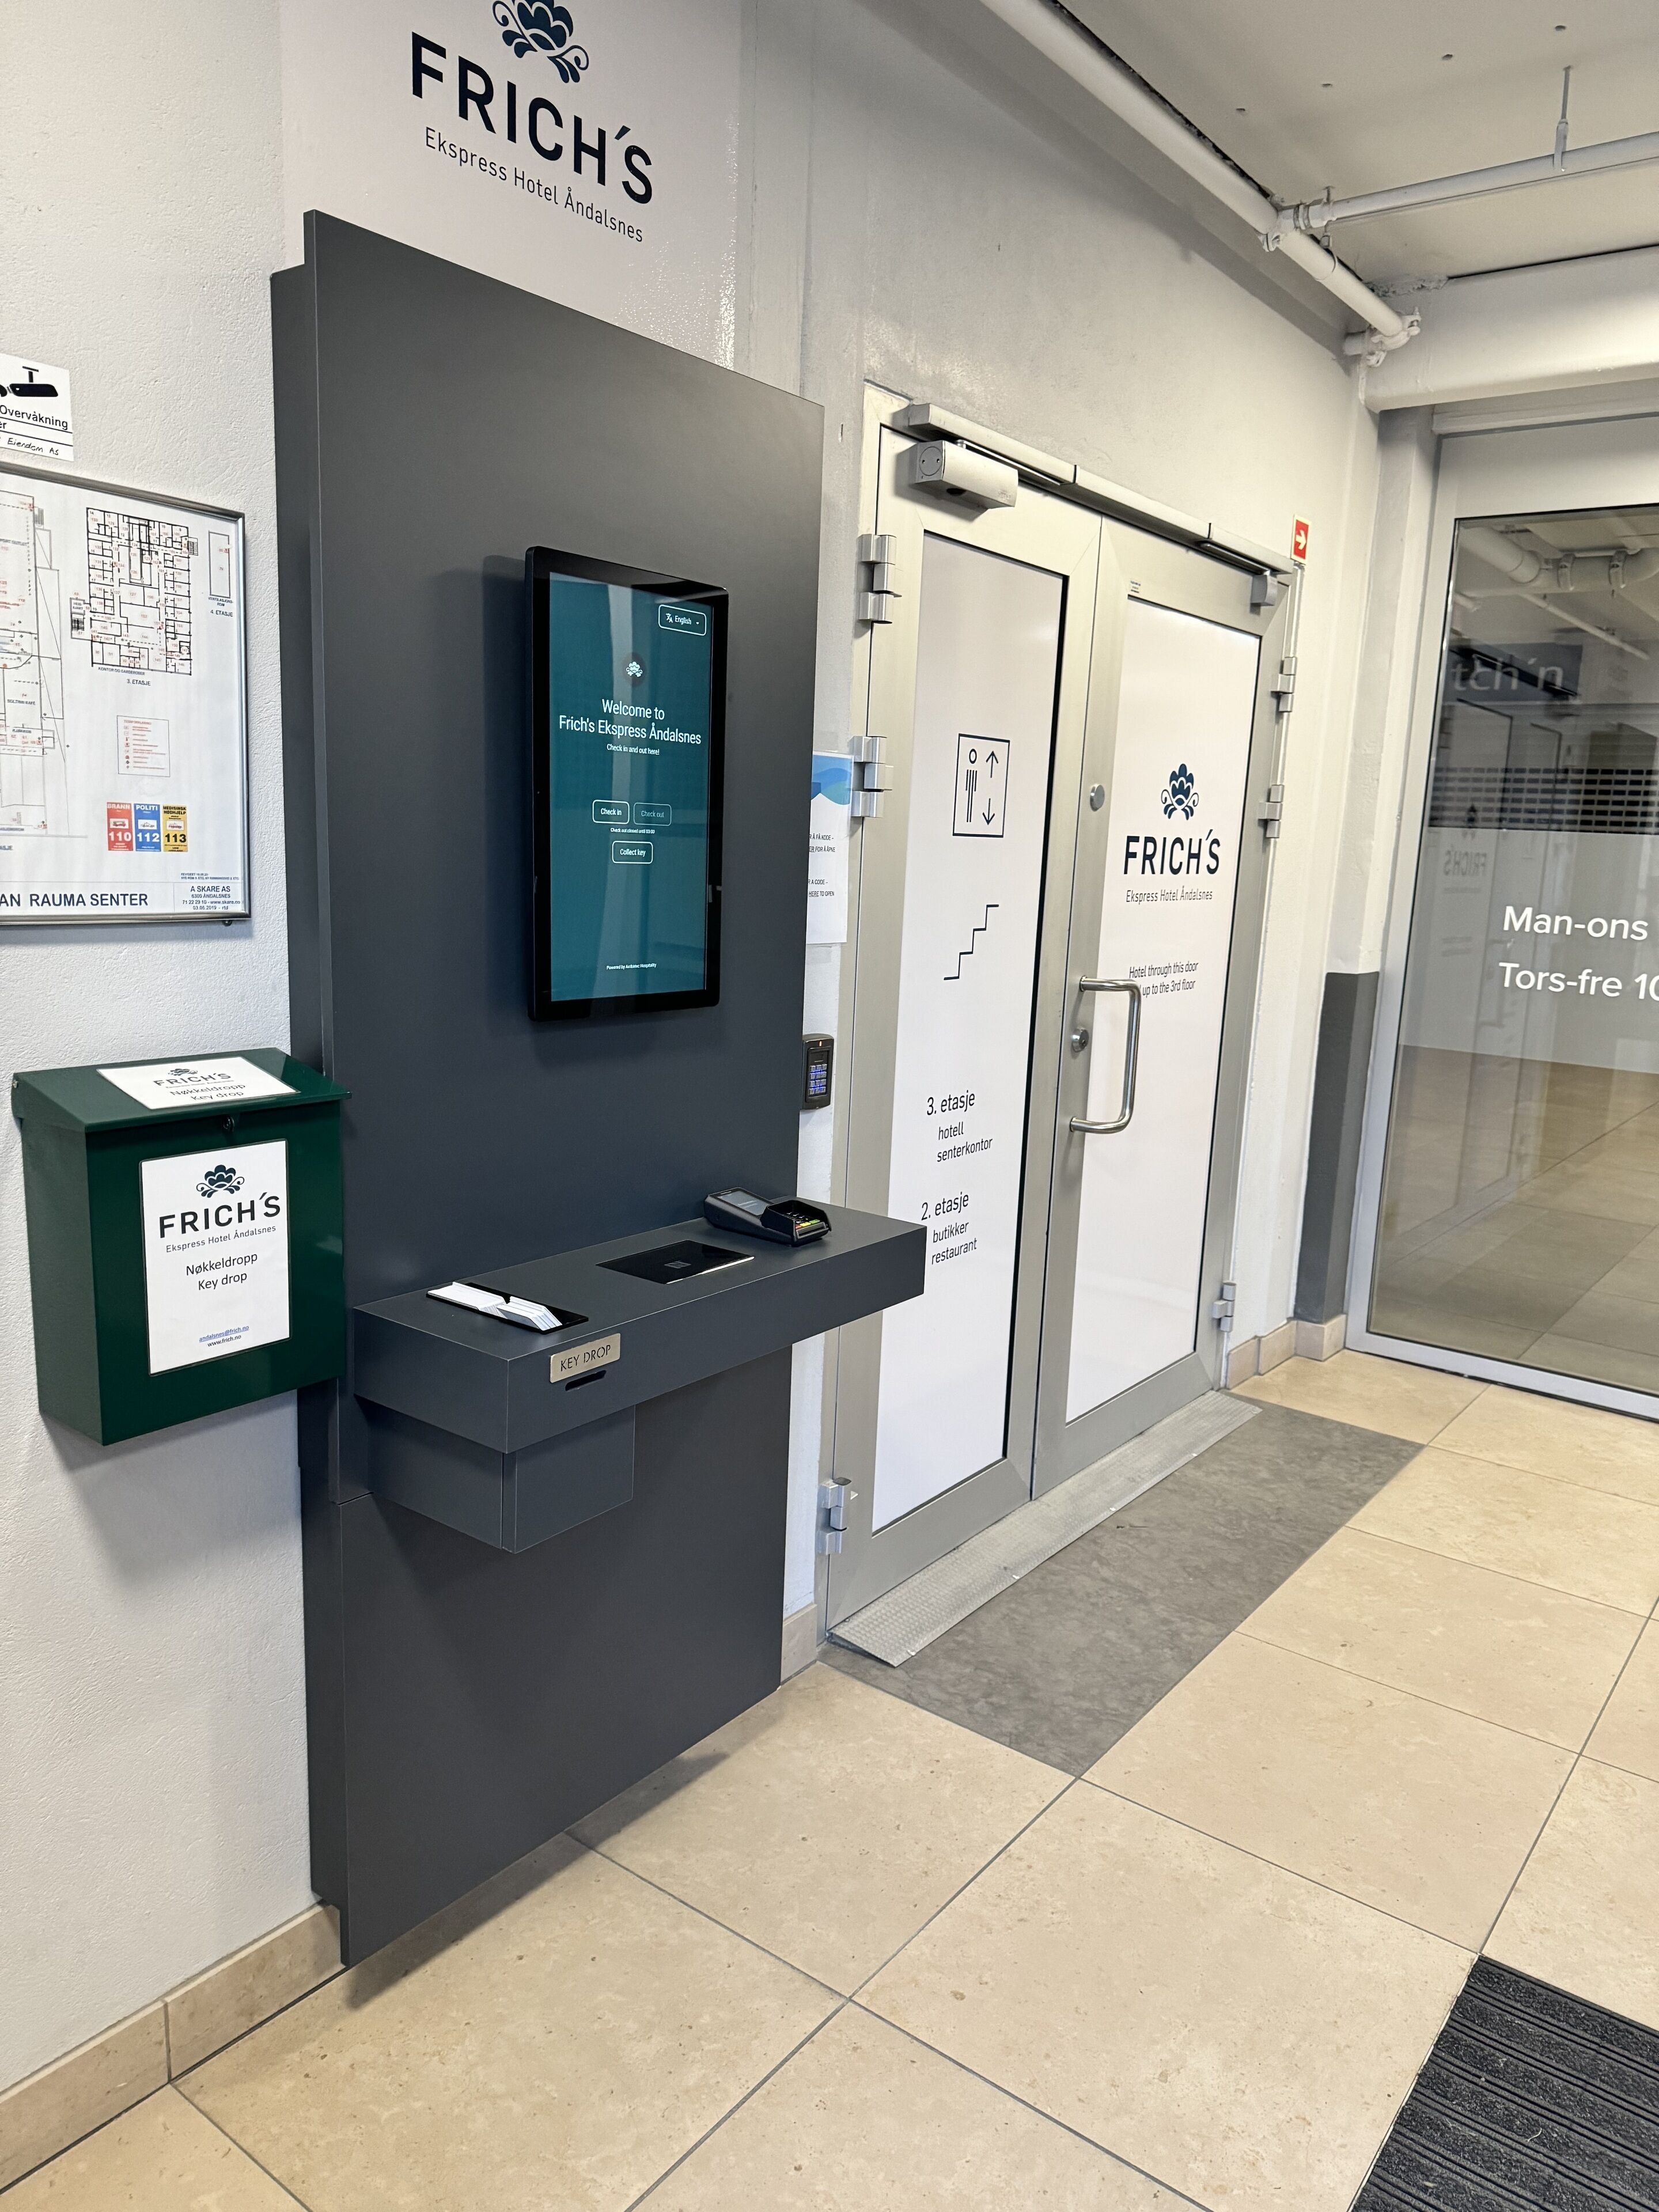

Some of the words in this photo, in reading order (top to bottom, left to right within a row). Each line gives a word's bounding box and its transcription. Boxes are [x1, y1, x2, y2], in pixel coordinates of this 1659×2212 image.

[411, 31, 653, 204] FRICH'S
[425, 126, 507, 181] Ekspress
[514, 167, 559, 205] Hotel
[564, 187, 643, 243] Åndalsnes
[674, 615, 692, 625] English
[601, 699, 652, 718] Welcome
[654, 707, 665, 720] to
[559, 715, 595, 733] Frich's
[598, 720, 646, 738] Ekspress
[649, 722, 701, 744] Åndalsnes
[607, 744, 622, 752] Check
[109, 831, 132, 842] 110
[137, 832, 160, 842] 112
[165, 833, 187, 843] 113
[637, 849, 646, 857] key
[1123, 829, 1221, 875] FRICH'S
[30, 893, 86, 907] RAUMA
[90, 893, 148, 907] SENTER
[1126, 889, 1158, 905] Ekspress
[1160, 889, 1179, 901] Hotel
[1180, 885, 1213, 901] Åndalsnes
[1503, 906, 1649, 941] Man-ons
[1129, 965, 1146, 979] Hotel
[1148, 963, 1172, 978] through
[1173, 961, 1184, 974] this
[1185, 961, 1199, 972] door
[1498, 961, 1623, 997] Tors-fre
[1142, 986, 1150, 998] up
[1152, 984, 1158, 994] to
[1160, 982, 1169, 994] the
[1171, 979, 1181, 992] 3rd
[1182, 979, 1196, 990] floor
[170, 1084, 246, 1096] Nøkkeldropp
[926, 1096, 937, 1116] 3.
[941, 1089, 975, 1113] etasje
[938, 1122, 964, 1141] hotell
[937, 1138, 993, 1162] senterkontor
[159, 1192, 281, 1238] FRICH'S
[921, 1202, 931, 1221] 2.
[934, 1191, 969, 1217] etasje
[166, 1238, 205, 1253] Ekspress
[208, 1233, 231, 1245] Hotel
[233, 1225, 276, 1240] Åndalsnes
[933, 1222, 969, 1243] butikker
[931, 1238, 978, 1265] restaurant
[186, 1252, 258, 1276] Nøkkeldropp
[198, 1278, 218, 1290] Key
[221, 1271, 248, 1286] drop
[199, 1325, 249, 1342] andalsnes@frich.no
[207, 1335, 241, 1347] www.frich.no
[560, 1354, 579, 1372] KEY
[584, 1344, 611, 1363] DROP
